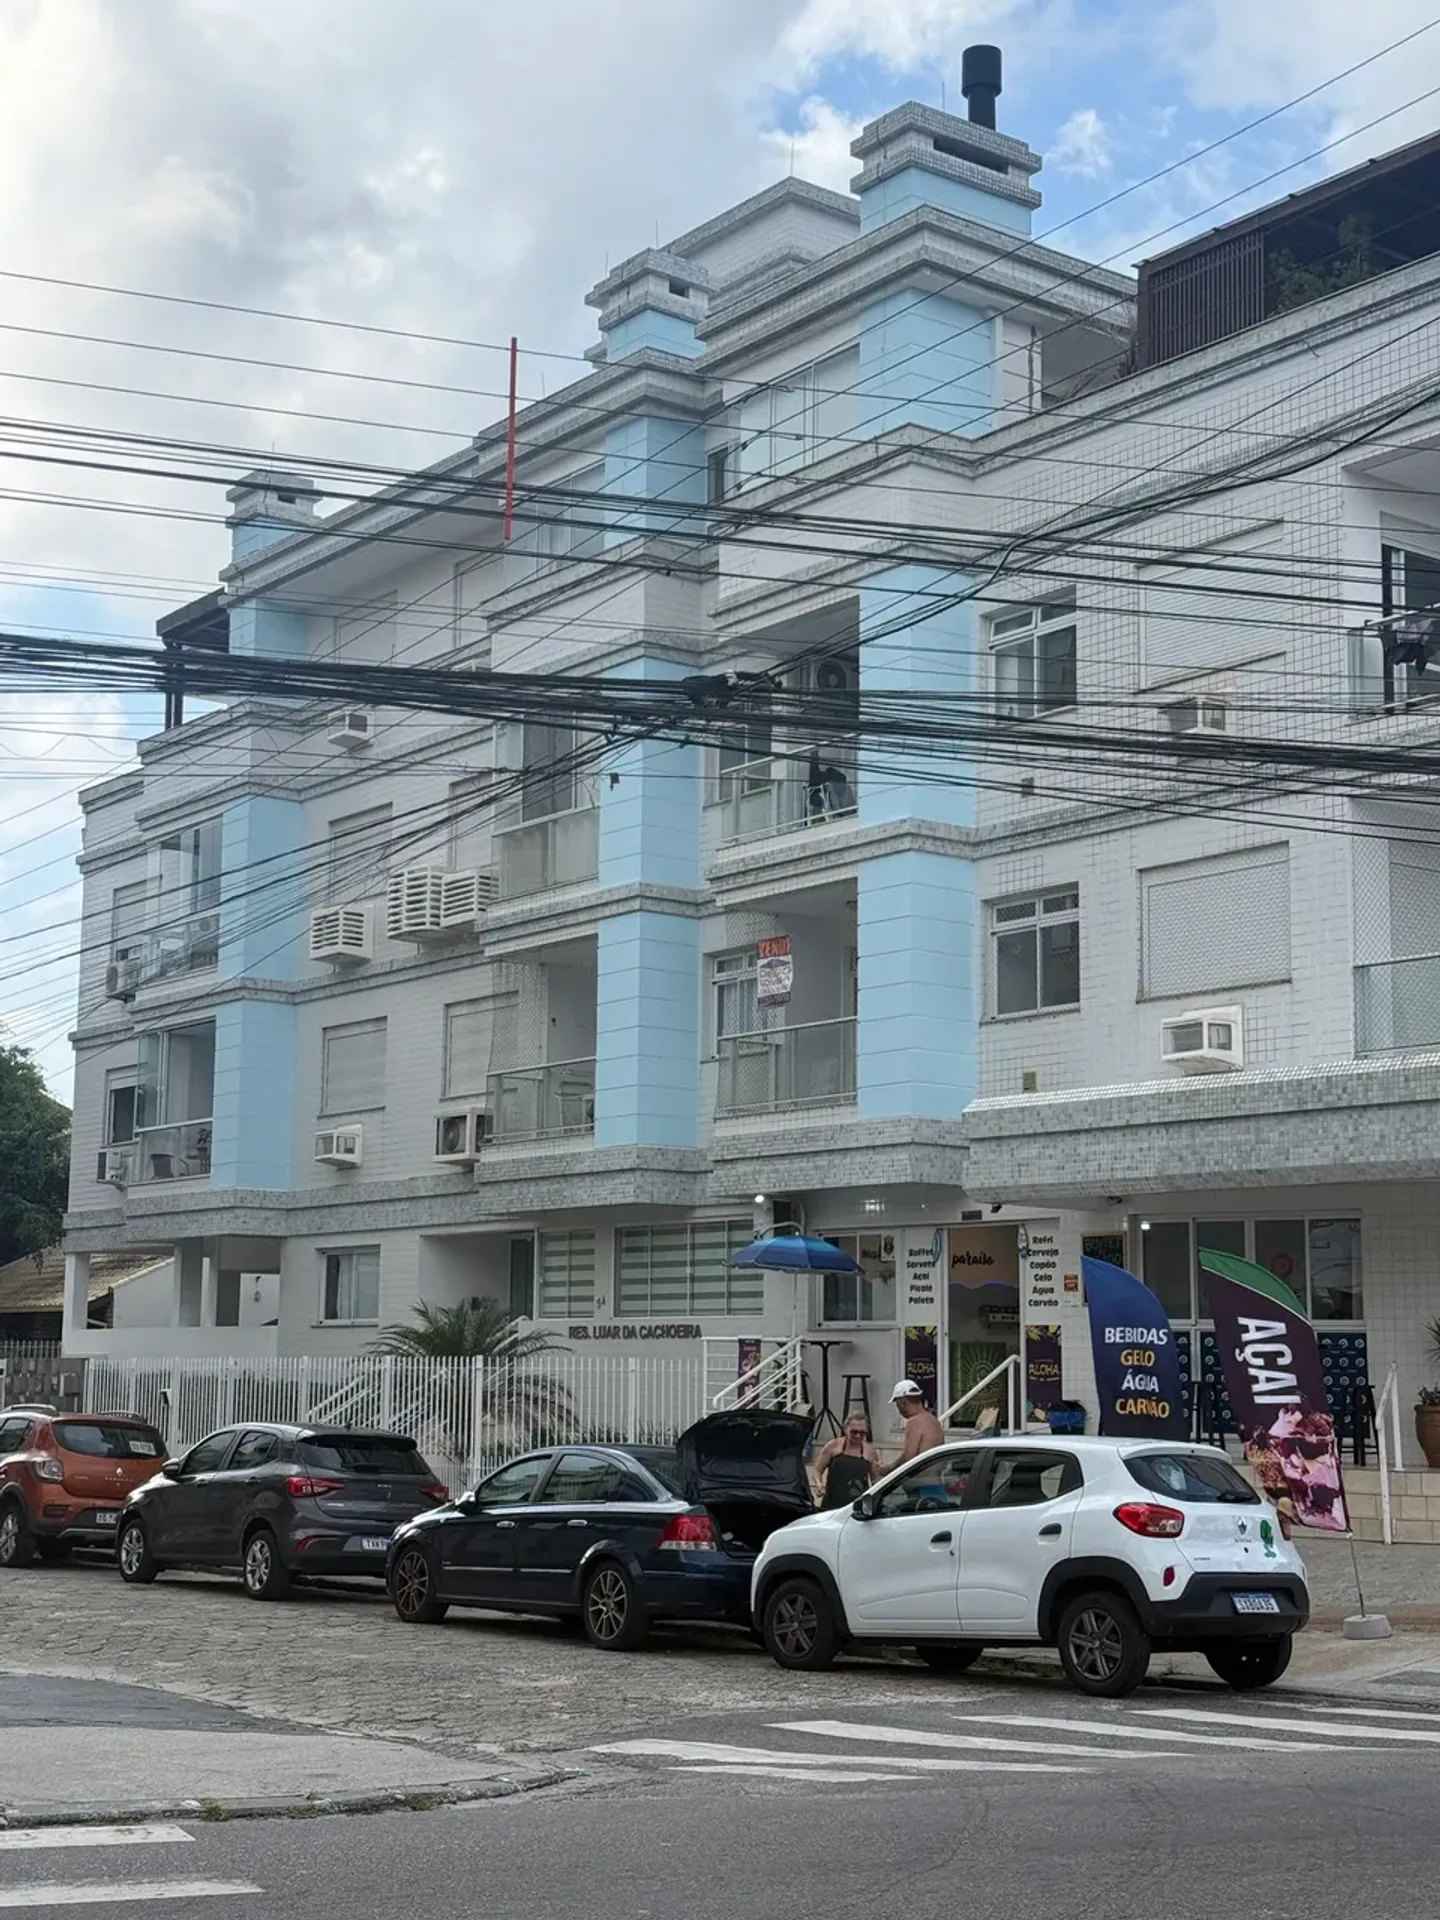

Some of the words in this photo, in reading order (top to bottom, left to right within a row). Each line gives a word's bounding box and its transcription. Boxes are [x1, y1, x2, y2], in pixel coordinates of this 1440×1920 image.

[1032, 1235, 1054, 1245] Refri
[908, 1248, 933, 1257] Buffet
[1027, 1247, 1059, 1257] Cerveja
[906, 1260, 936, 1269] Sorvete
[568, 1326, 591, 1340] RES.
[593, 1325, 621, 1340] LUAR
[622, 1325, 638, 1339] DA
[640, 1324, 703, 1339] CACHOEIRA
[1104, 1327, 1168, 1345] BEBIDAS
[1120, 1349, 1155, 1367] GELO
[1235, 1317, 1302, 1404] AÇAI
[907, 1361, 935, 1374] ALOHA
[1028, 1363, 1059, 1376] ALOHA
[1121, 1369, 1159, 1393] ÁGUA
[1115, 1397, 1170, 1418] CARVÃO
